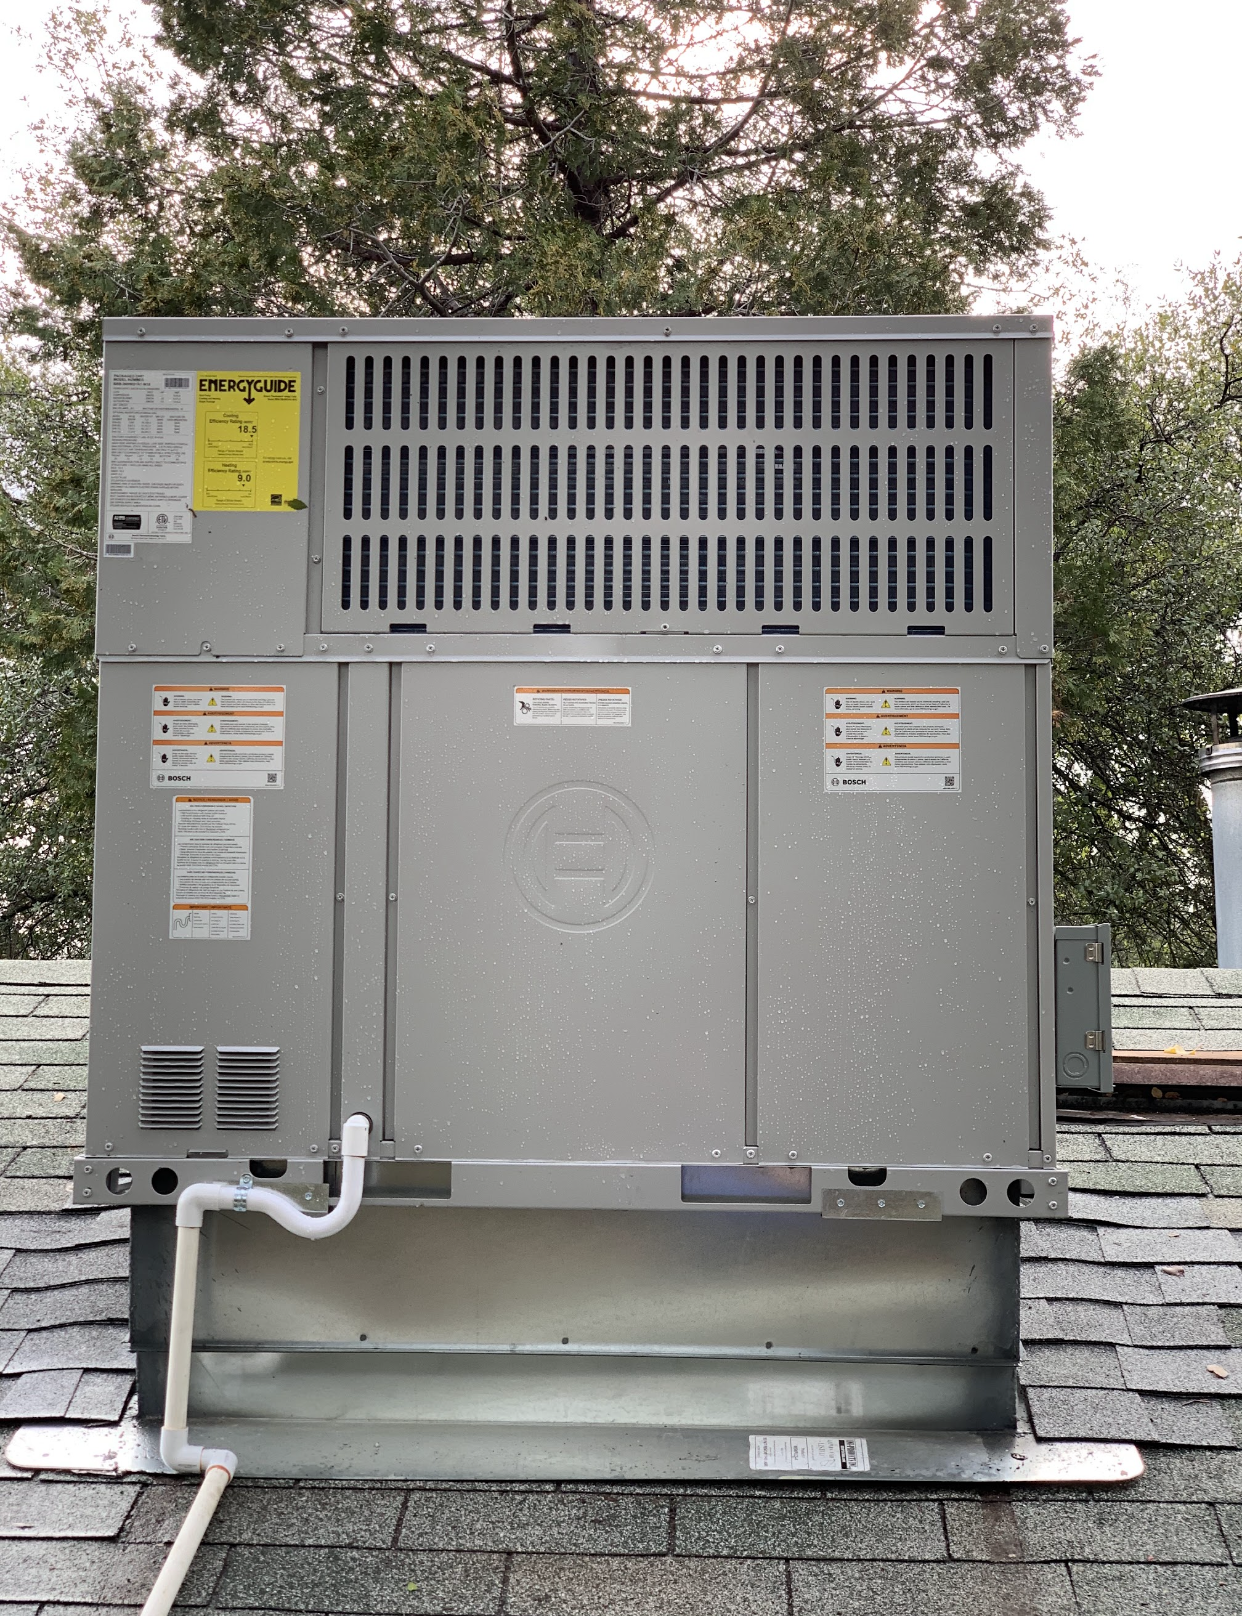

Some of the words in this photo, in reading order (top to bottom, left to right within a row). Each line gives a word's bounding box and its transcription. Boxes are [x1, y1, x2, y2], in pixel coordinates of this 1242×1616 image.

[199, 378, 296, 393] ENERGYGUIDE
[238, 425, 257, 434] 18.5
[237, 474, 252, 482] 9.0
